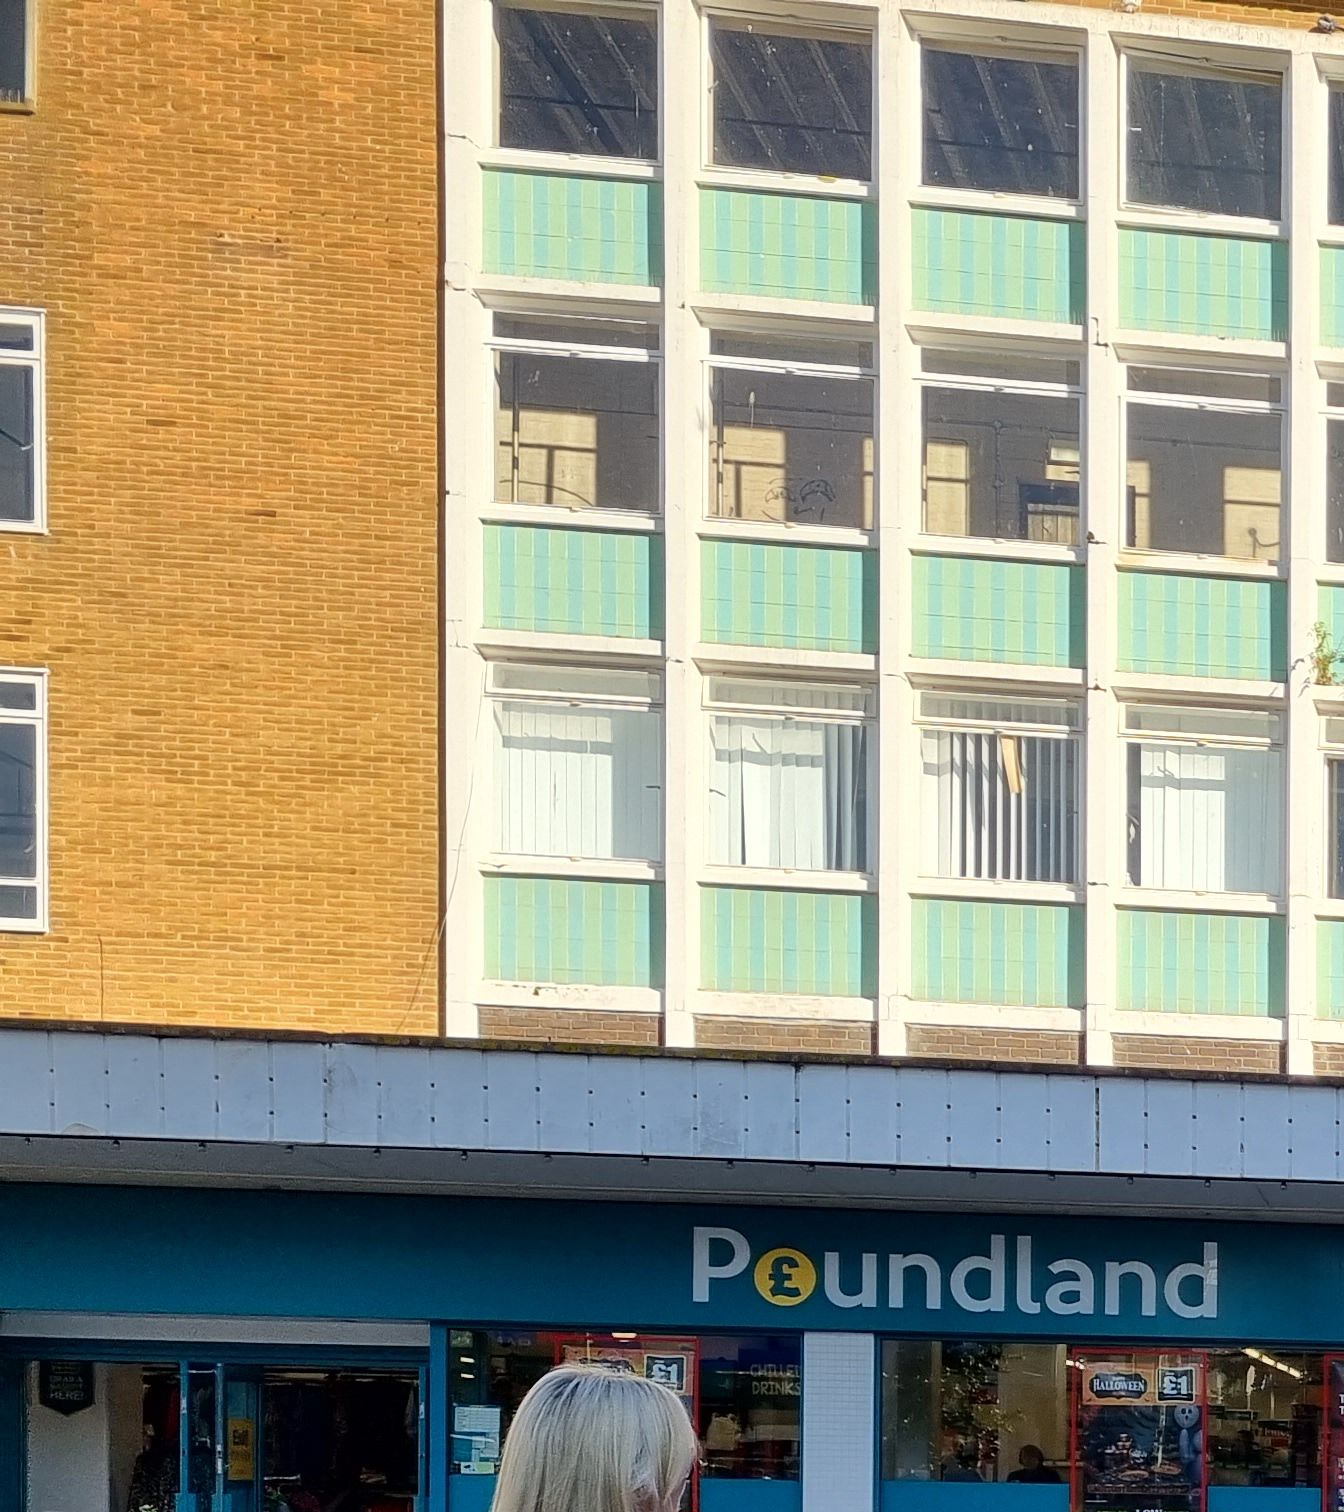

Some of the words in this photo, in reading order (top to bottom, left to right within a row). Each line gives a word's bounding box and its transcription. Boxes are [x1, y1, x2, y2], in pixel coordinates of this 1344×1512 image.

[751, 1380, 801, 1396] DRINKS
[1093, 1378, 1145, 1392] HALLOWEEN
[1163, 1374, 1189, 1395] £1
